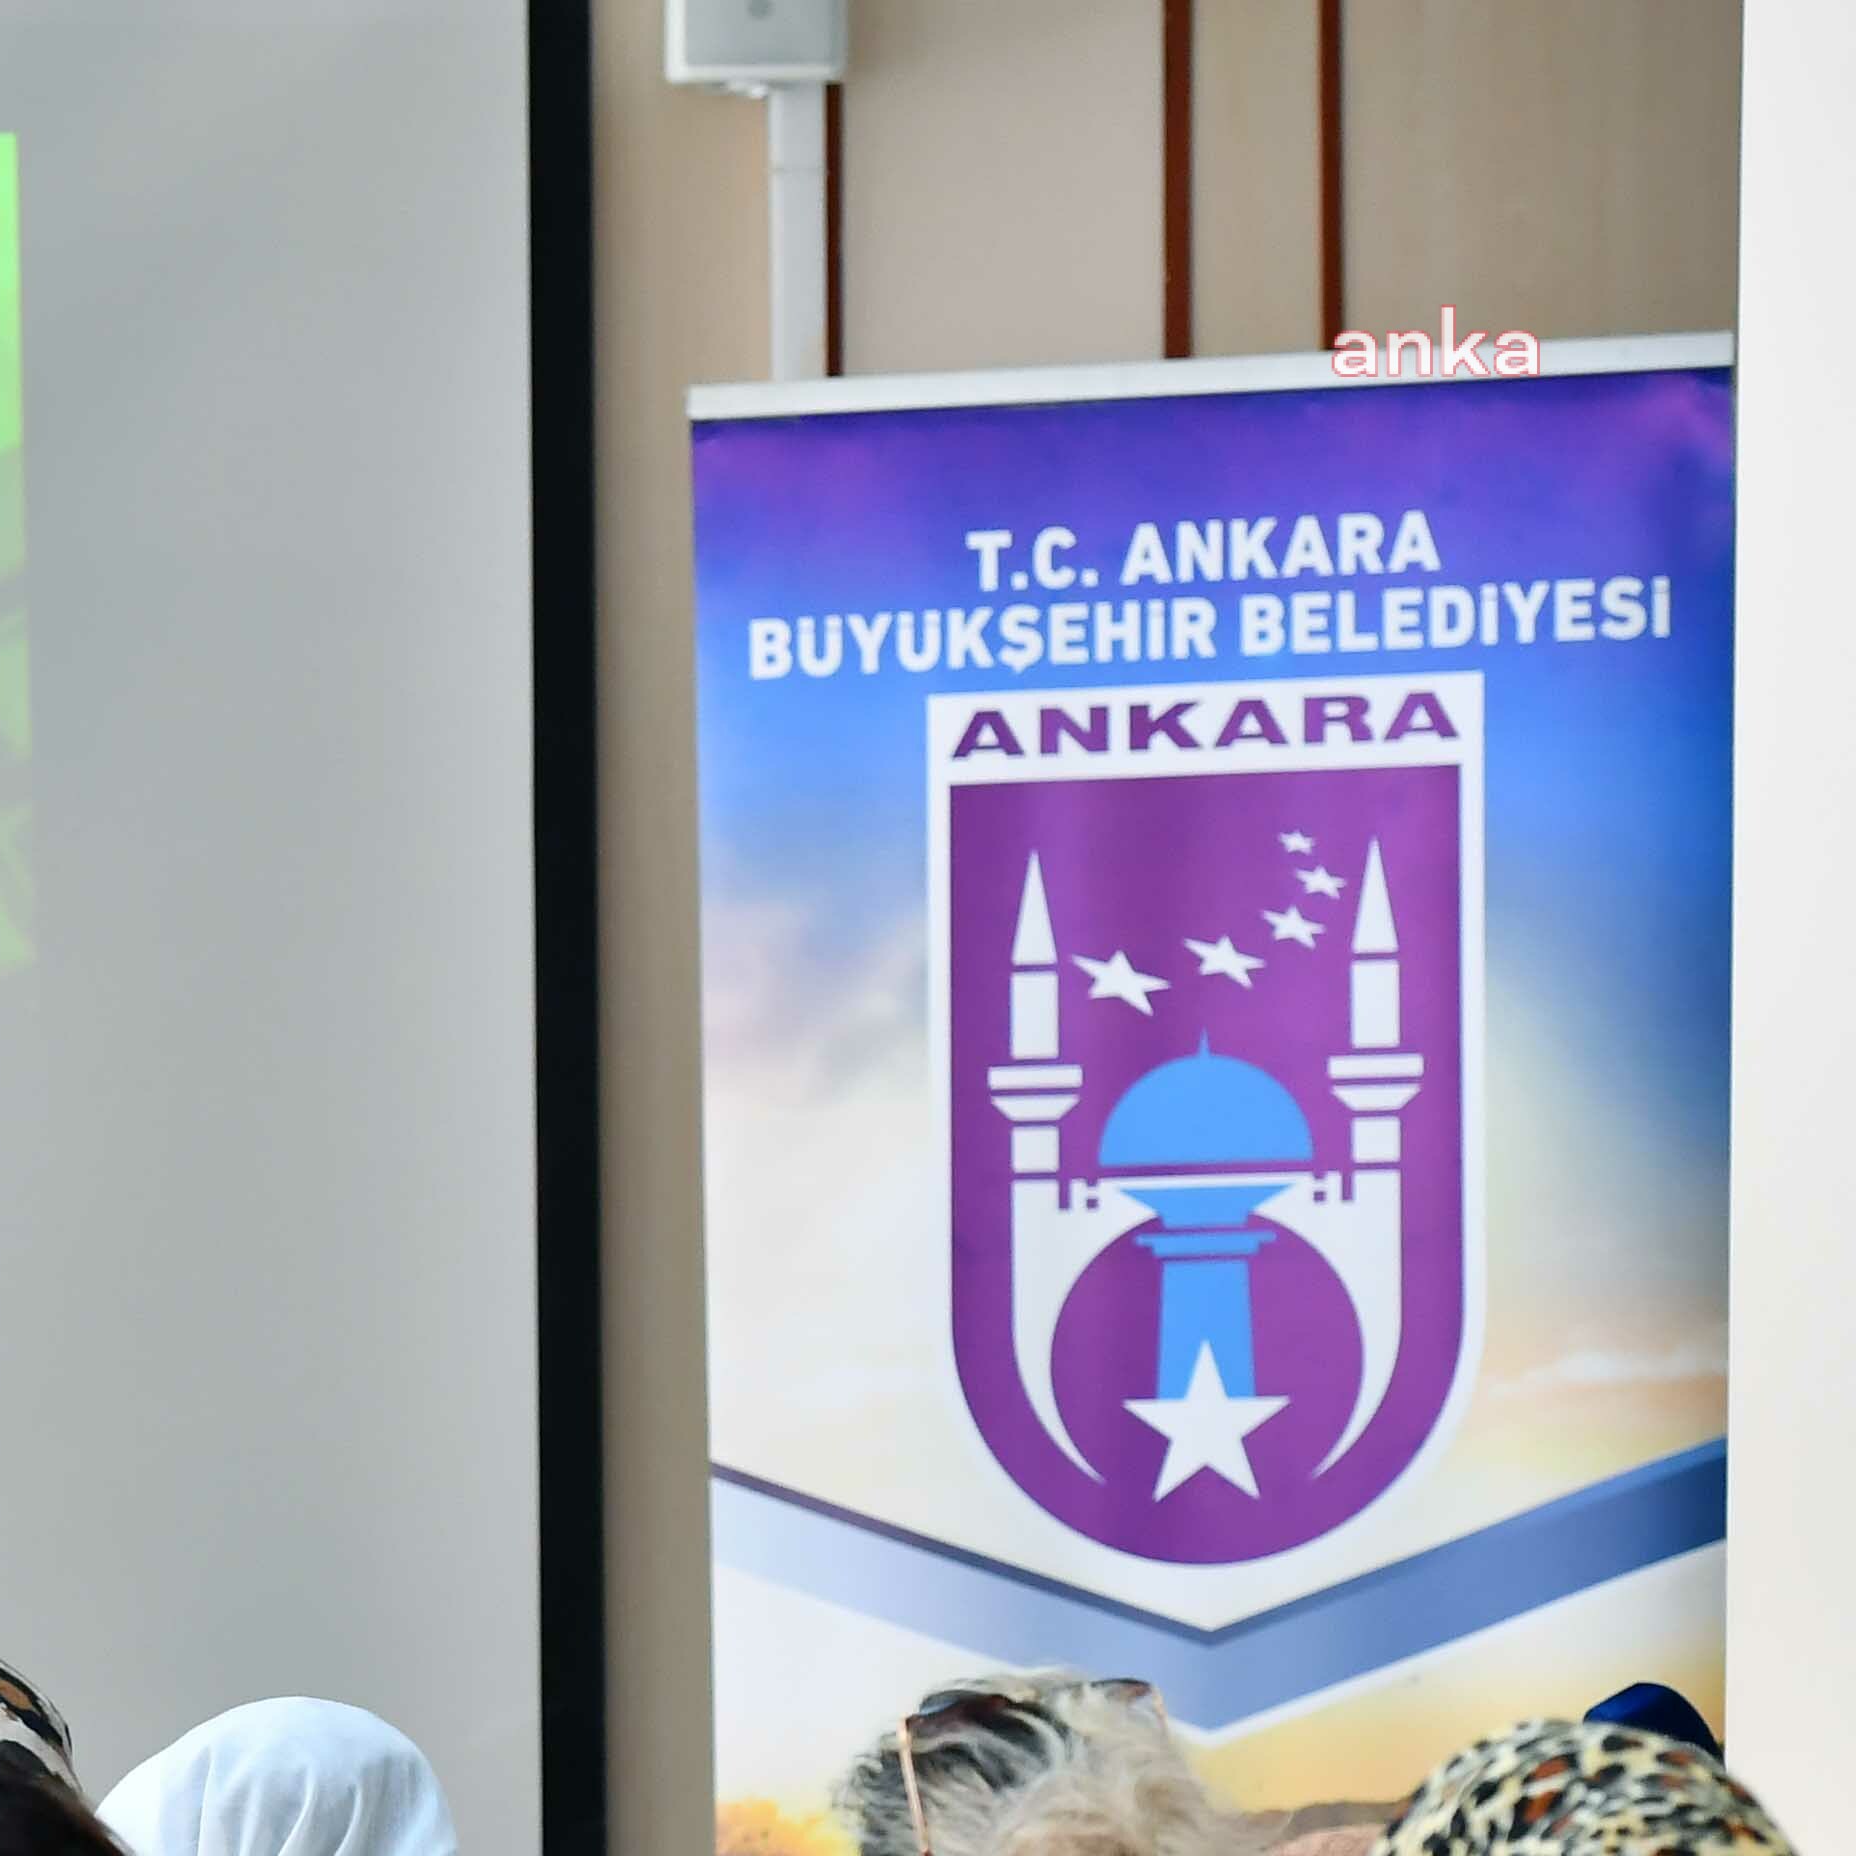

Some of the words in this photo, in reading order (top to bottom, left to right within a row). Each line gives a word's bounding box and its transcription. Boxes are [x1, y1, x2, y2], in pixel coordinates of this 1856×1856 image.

[967, 528, 1098, 590] T.C.
[1122, 511, 1441, 586] ANKARA
[750, 592, 1216, 680] BÜYÜKŞEHİR
[1243, 577, 1670, 657] BELEDİYESİ
[952, 691, 1459, 760] ANKARA
